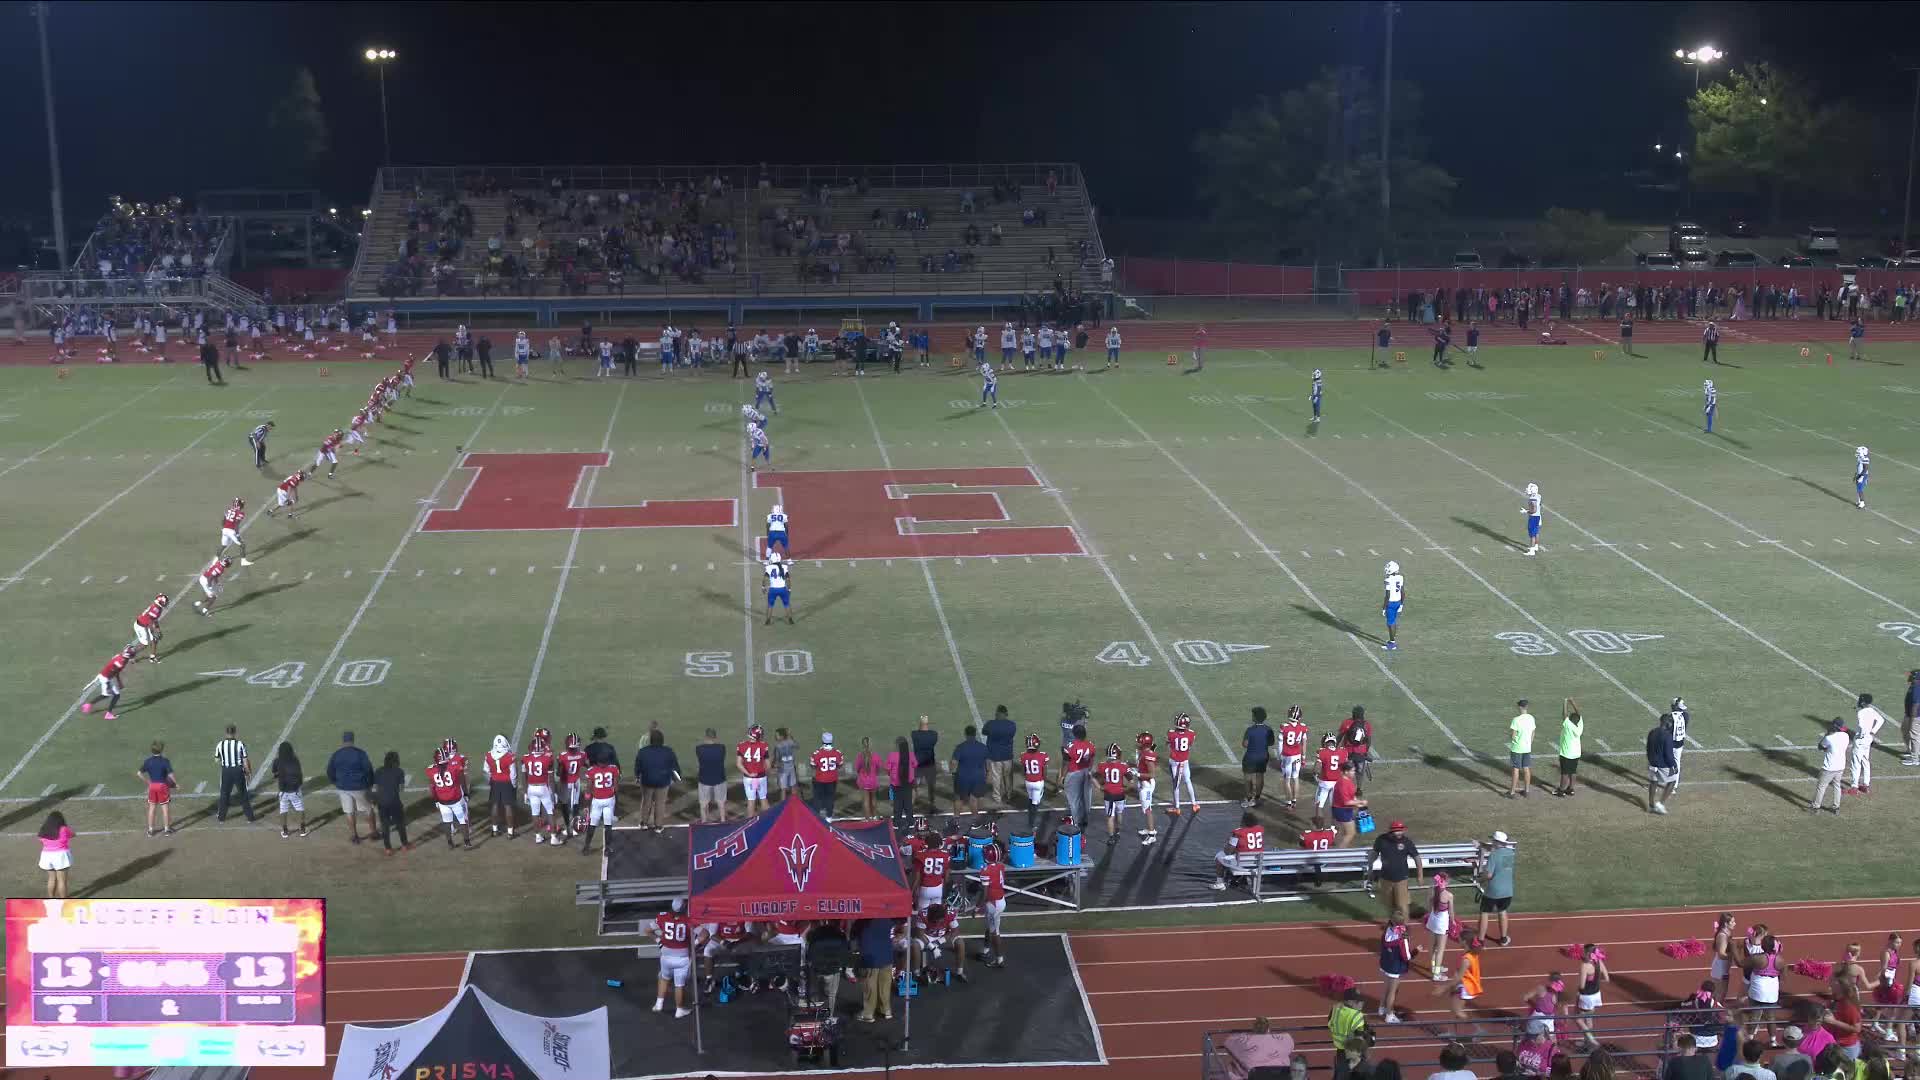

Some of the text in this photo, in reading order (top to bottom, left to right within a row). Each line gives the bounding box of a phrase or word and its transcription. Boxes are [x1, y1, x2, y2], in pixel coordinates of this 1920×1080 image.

[771, 514, 784, 523] 50
[1174, 737, 1190, 752] 18
[743, 747, 762, 763] 44
[1330, 755, 1340, 771] 5
[495, 759, 502, 774] 1
[527, 761, 544, 777] 13
[819, 756, 838, 772] 35
[1024, 759, 1040, 775] 16
[594, 772, 613, 789] 23
[1104, 767, 1121, 784] 10
[1246, 831, 1263, 850] 92
[924, 857, 944, 875] 85
[740, 899, 800, 916] LUGOFF
[817, 898, 863, 914] ELGIN
[664, 921, 687, 942] 50
[40, 956, 93, 988] 13
[233, 955, 286, 988] 13
